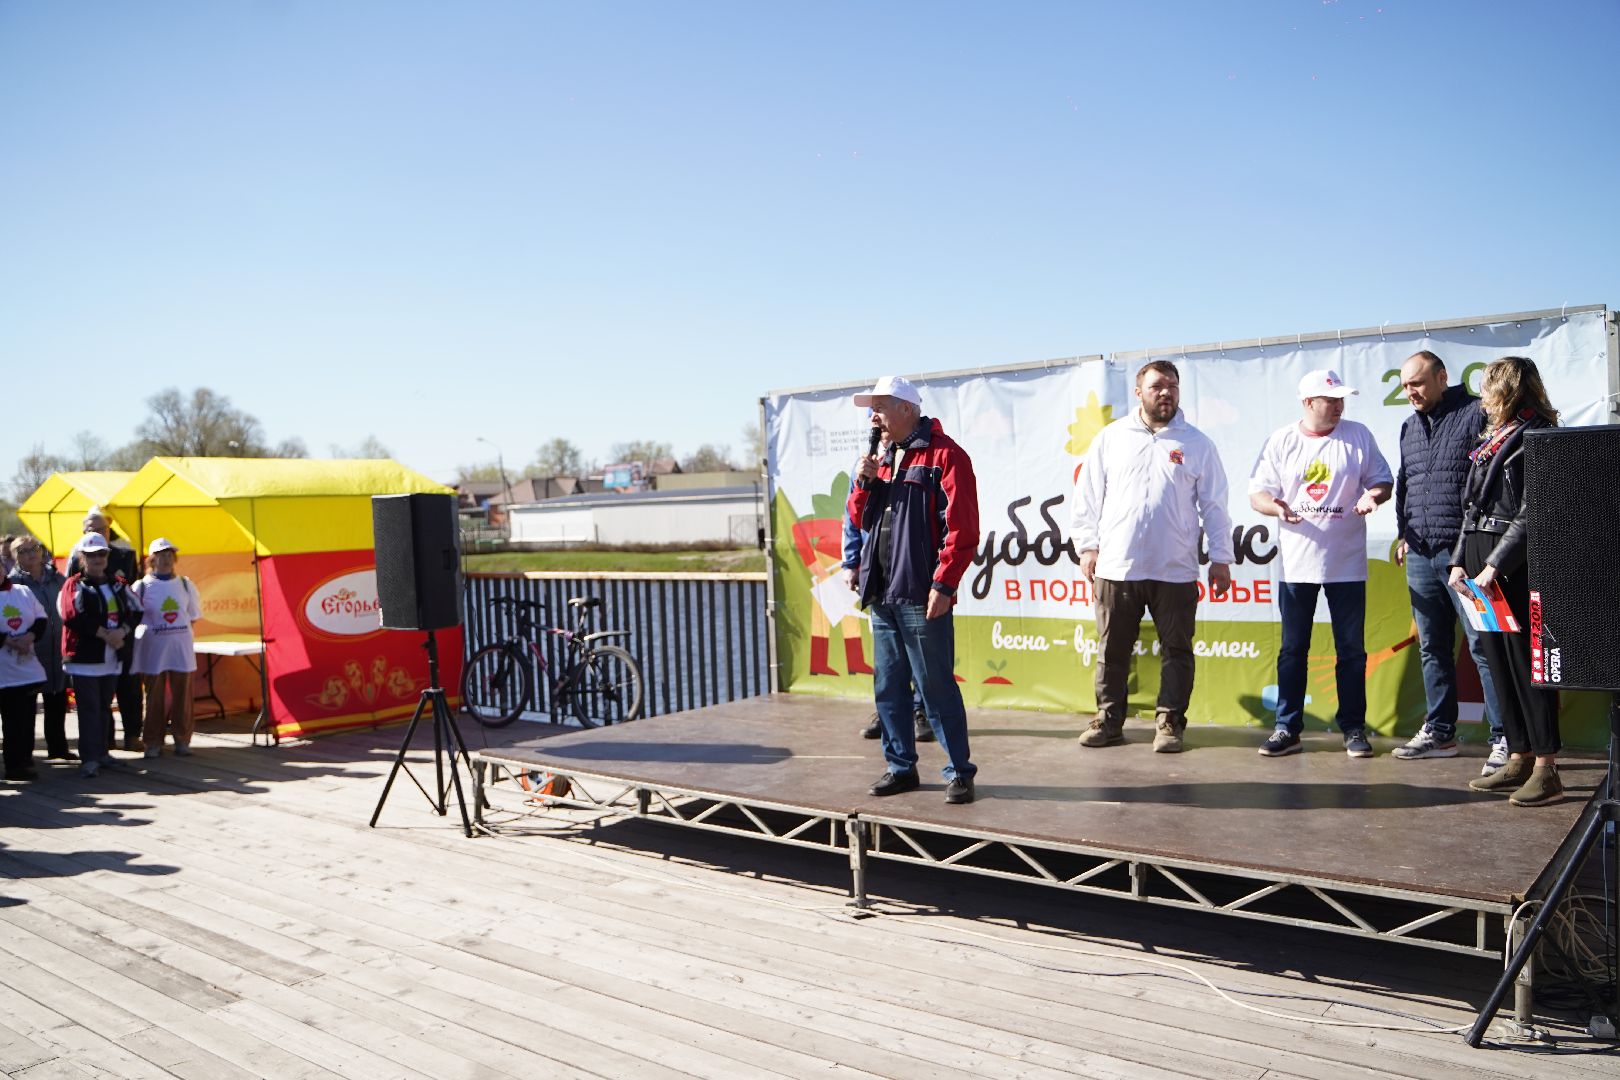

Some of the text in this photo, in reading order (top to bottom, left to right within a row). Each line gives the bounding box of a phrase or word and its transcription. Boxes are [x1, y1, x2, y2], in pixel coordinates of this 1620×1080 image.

[1004, 579, 1022, 601] В
[991, 620, 1050, 650] весна
[1550, 647, 1562, 683] OPERA
